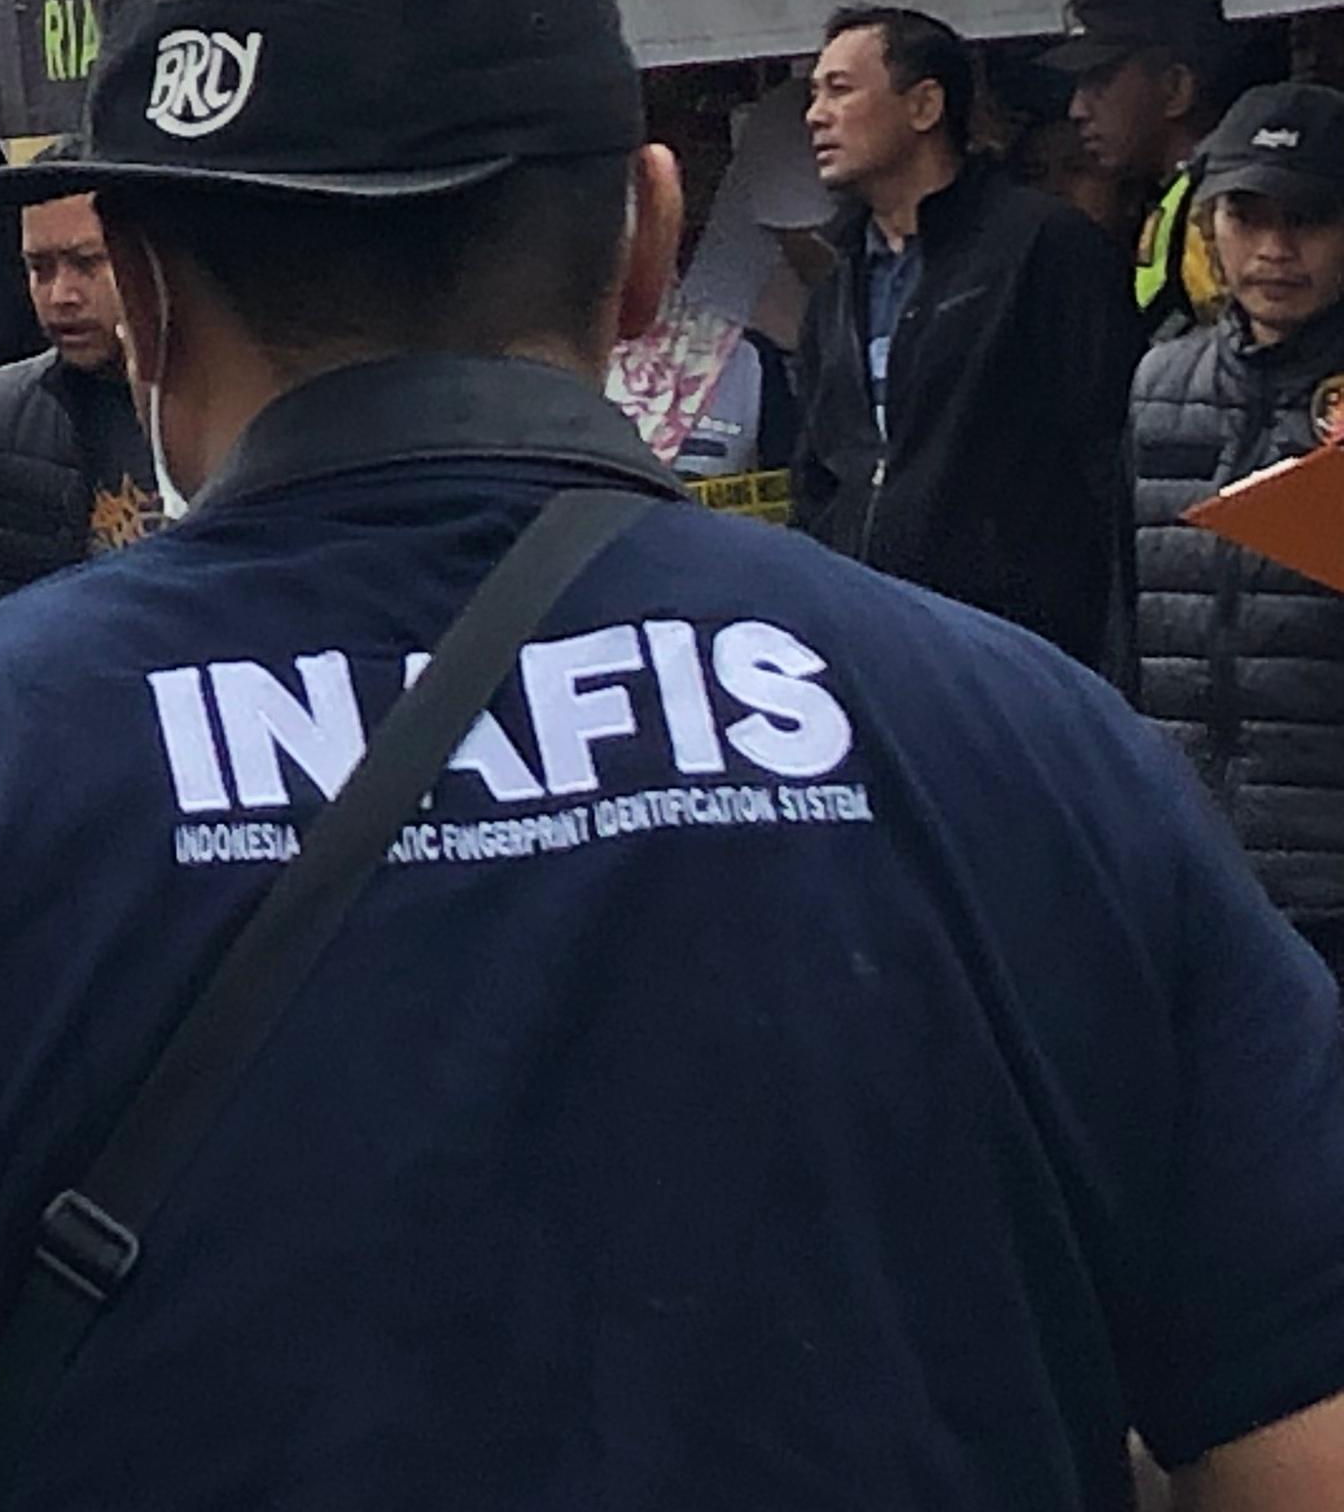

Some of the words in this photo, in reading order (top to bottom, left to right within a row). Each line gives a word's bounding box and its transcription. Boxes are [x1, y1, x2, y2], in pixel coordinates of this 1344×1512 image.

[175, 823, 301, 865] INDONESIA
[441, 807, 591, 862] FINGERPRINT
[593, 787, 776, 838] IDENTIFICATION
[778, 785, 873, 823] SYSTEM
